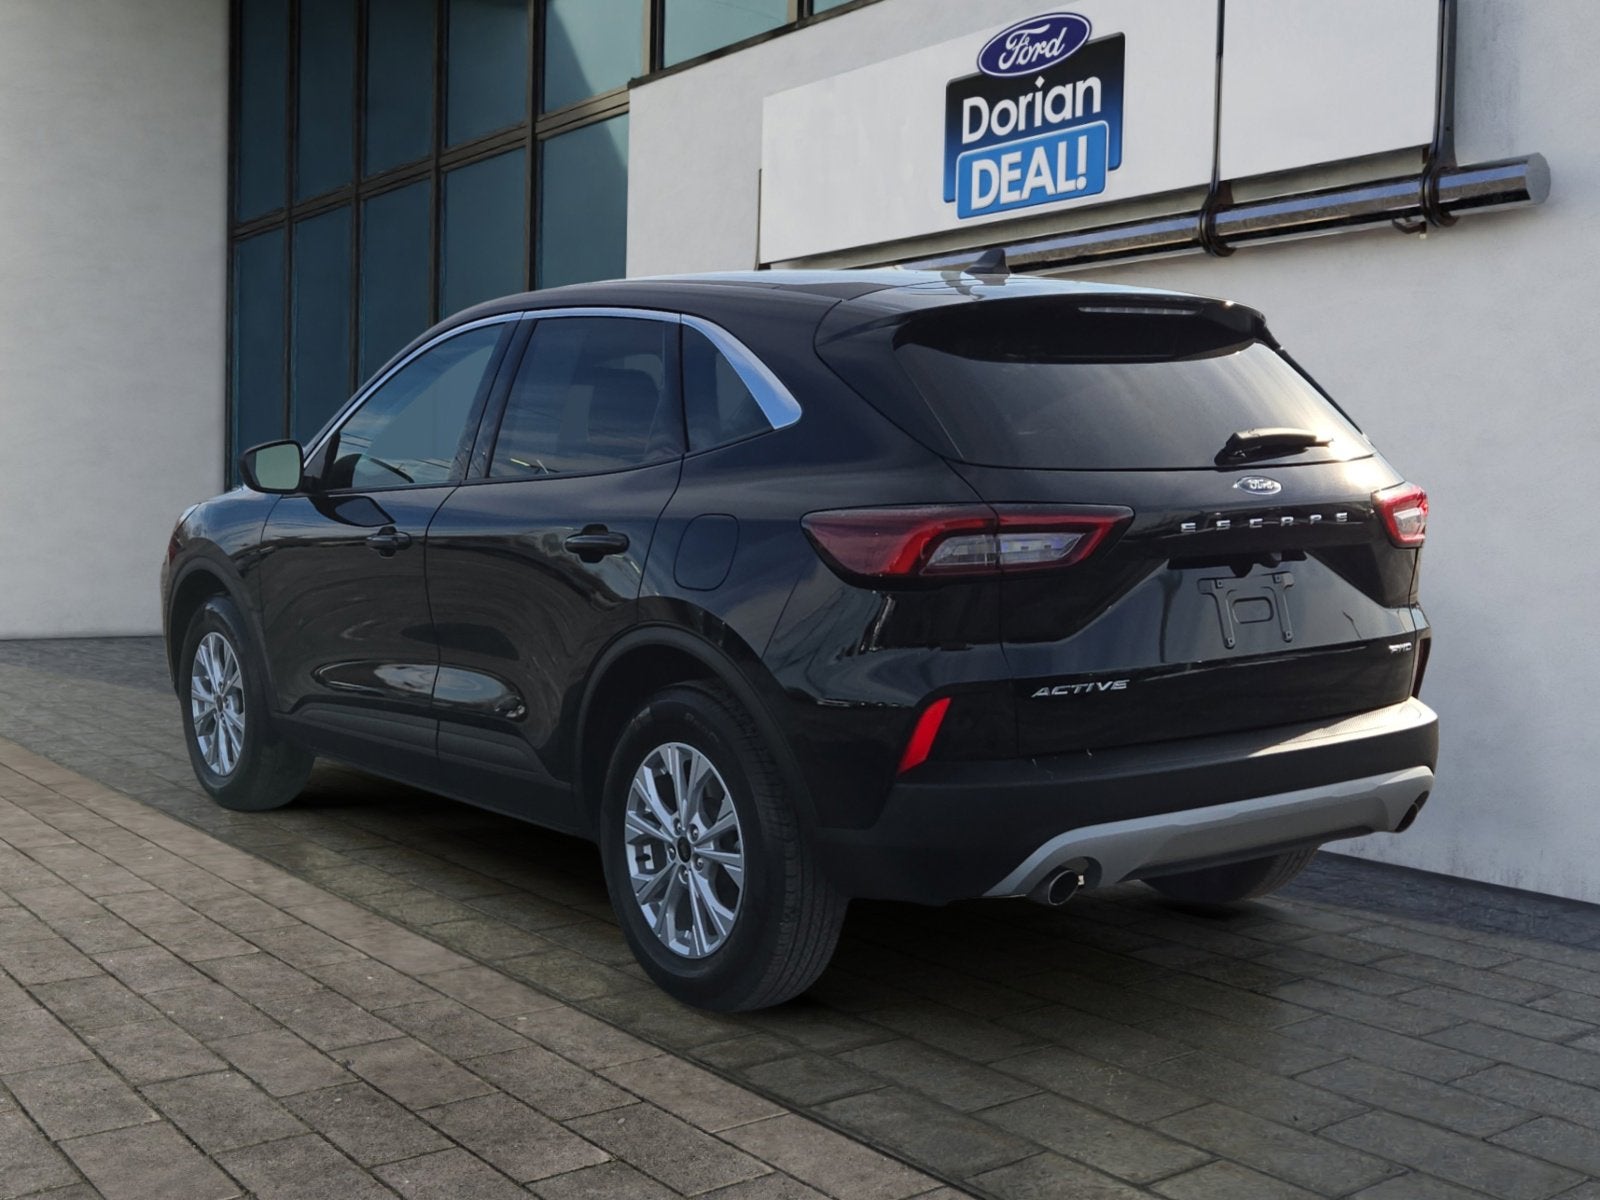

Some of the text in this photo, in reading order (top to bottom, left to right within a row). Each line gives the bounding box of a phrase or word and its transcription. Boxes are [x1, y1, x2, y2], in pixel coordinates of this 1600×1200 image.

[998, 24, 1067, 70] Ford
[962, 76, 1102, 145] Dorian
[971, 135, 1088, 210] DEAL!
[1180, 511, 1348, 533] ESCAPE
[1031, 679, 1130, 698] ACTIVE
